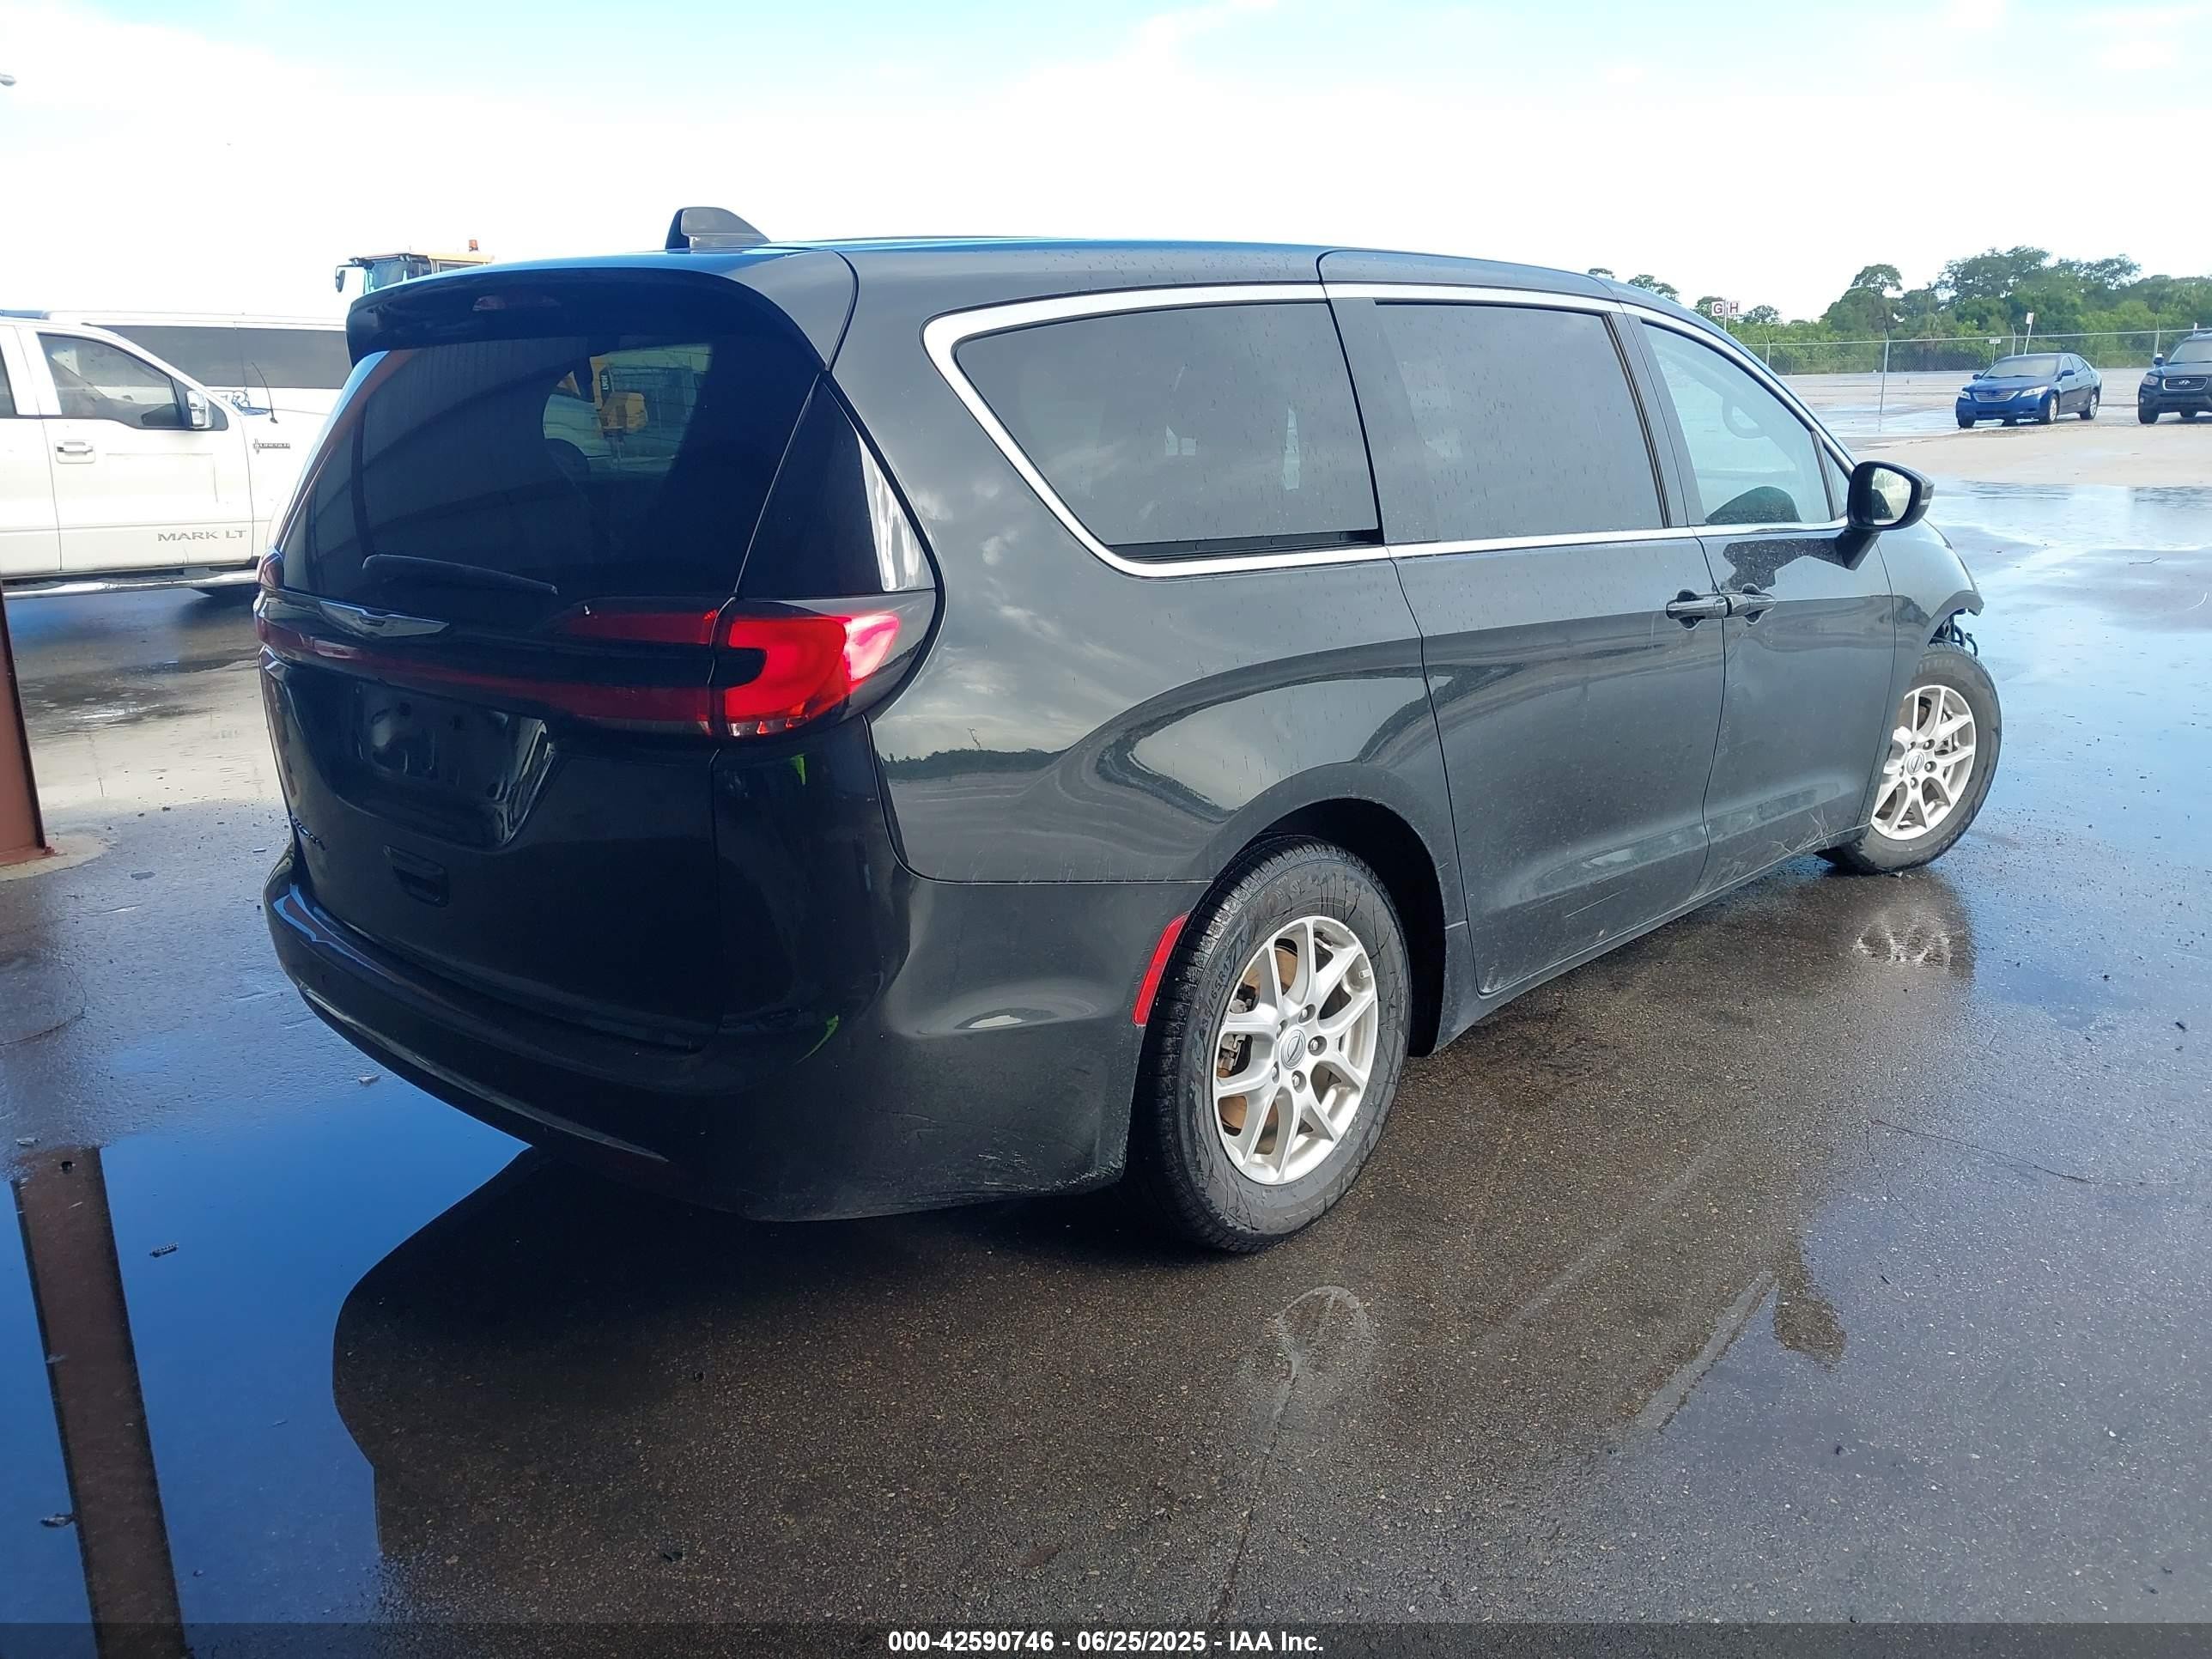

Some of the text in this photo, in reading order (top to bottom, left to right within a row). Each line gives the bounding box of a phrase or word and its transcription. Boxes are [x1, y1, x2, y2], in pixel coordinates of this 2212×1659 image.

[1714, 302, 1739, 313] G H
[157, 530, 247, 542] MARK LT
